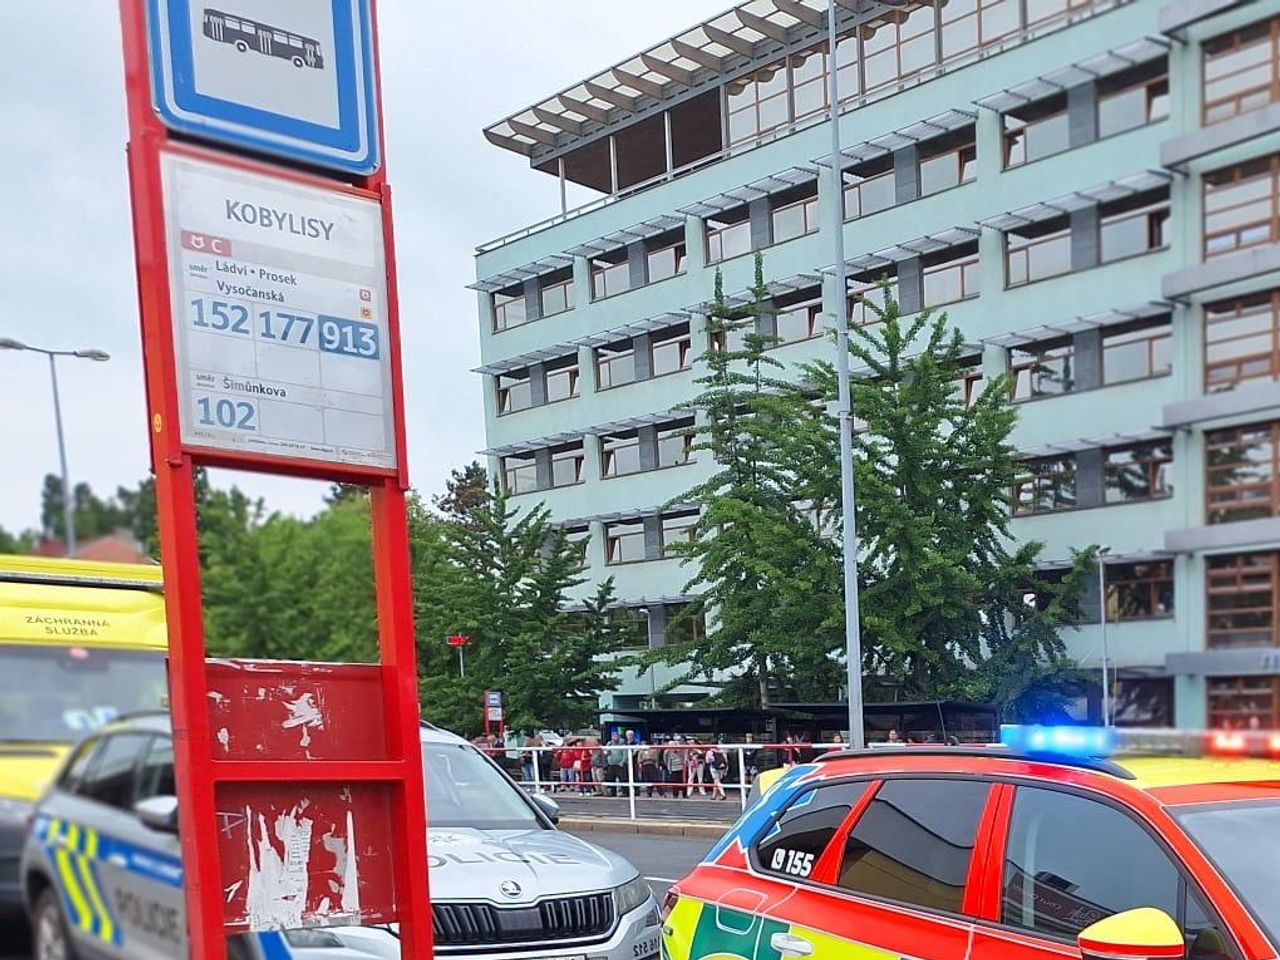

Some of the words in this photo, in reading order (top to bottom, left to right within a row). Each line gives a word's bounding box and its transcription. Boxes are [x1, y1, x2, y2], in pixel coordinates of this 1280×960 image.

[225, 199, 334, 241] KOBYLISY
[211, 239, 222, 253] C
[259, 268, 298, 286] Prosek
[217, 280, 285, 303] Vysočanská
[190, 298, 250, 335] 152
[258, 311, 315, 344] 177
[323, 321, 378, 355] 913
[223, 376, 287, 398] Šimůnkova
[197, 396, 256, 431] 102
[428, 852, 581, 868] OLICIE
[785, 849, 815, 877] 155
